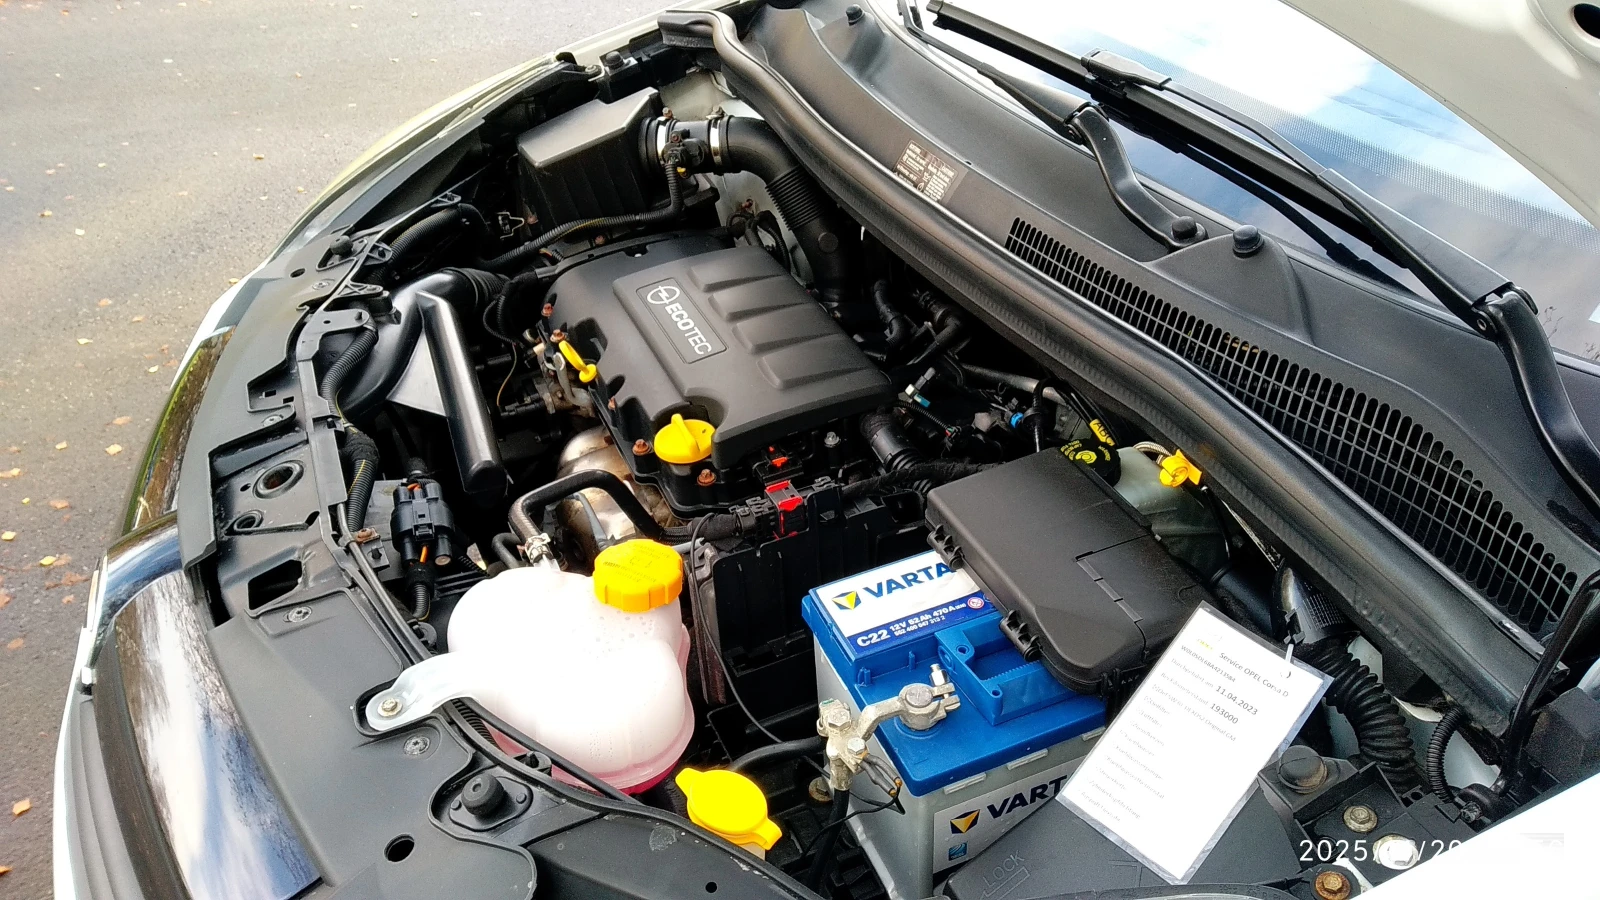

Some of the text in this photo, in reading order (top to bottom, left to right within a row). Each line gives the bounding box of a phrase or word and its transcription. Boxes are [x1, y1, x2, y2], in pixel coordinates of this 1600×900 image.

[664, 302, 712, 355] ECOTEC
[863, 561, 956, 599] VARTA
[856, 629, 891, 647] C22
[889, 621, 907, 632] 12V
[908, 613, 932, 625] 52Ah
[1219, 652, 1244, 671] Service
[1243, 667, 1261, 683] OPEL
[1262, 679, 1282, 695] Corsa
[1209, 702, 1239, 725] 193000
[1215, 685, 1258, 716] 11.04.2023
[987, 774, 1068, 820] VART
[982, 849, 1025, 887] LOCK
